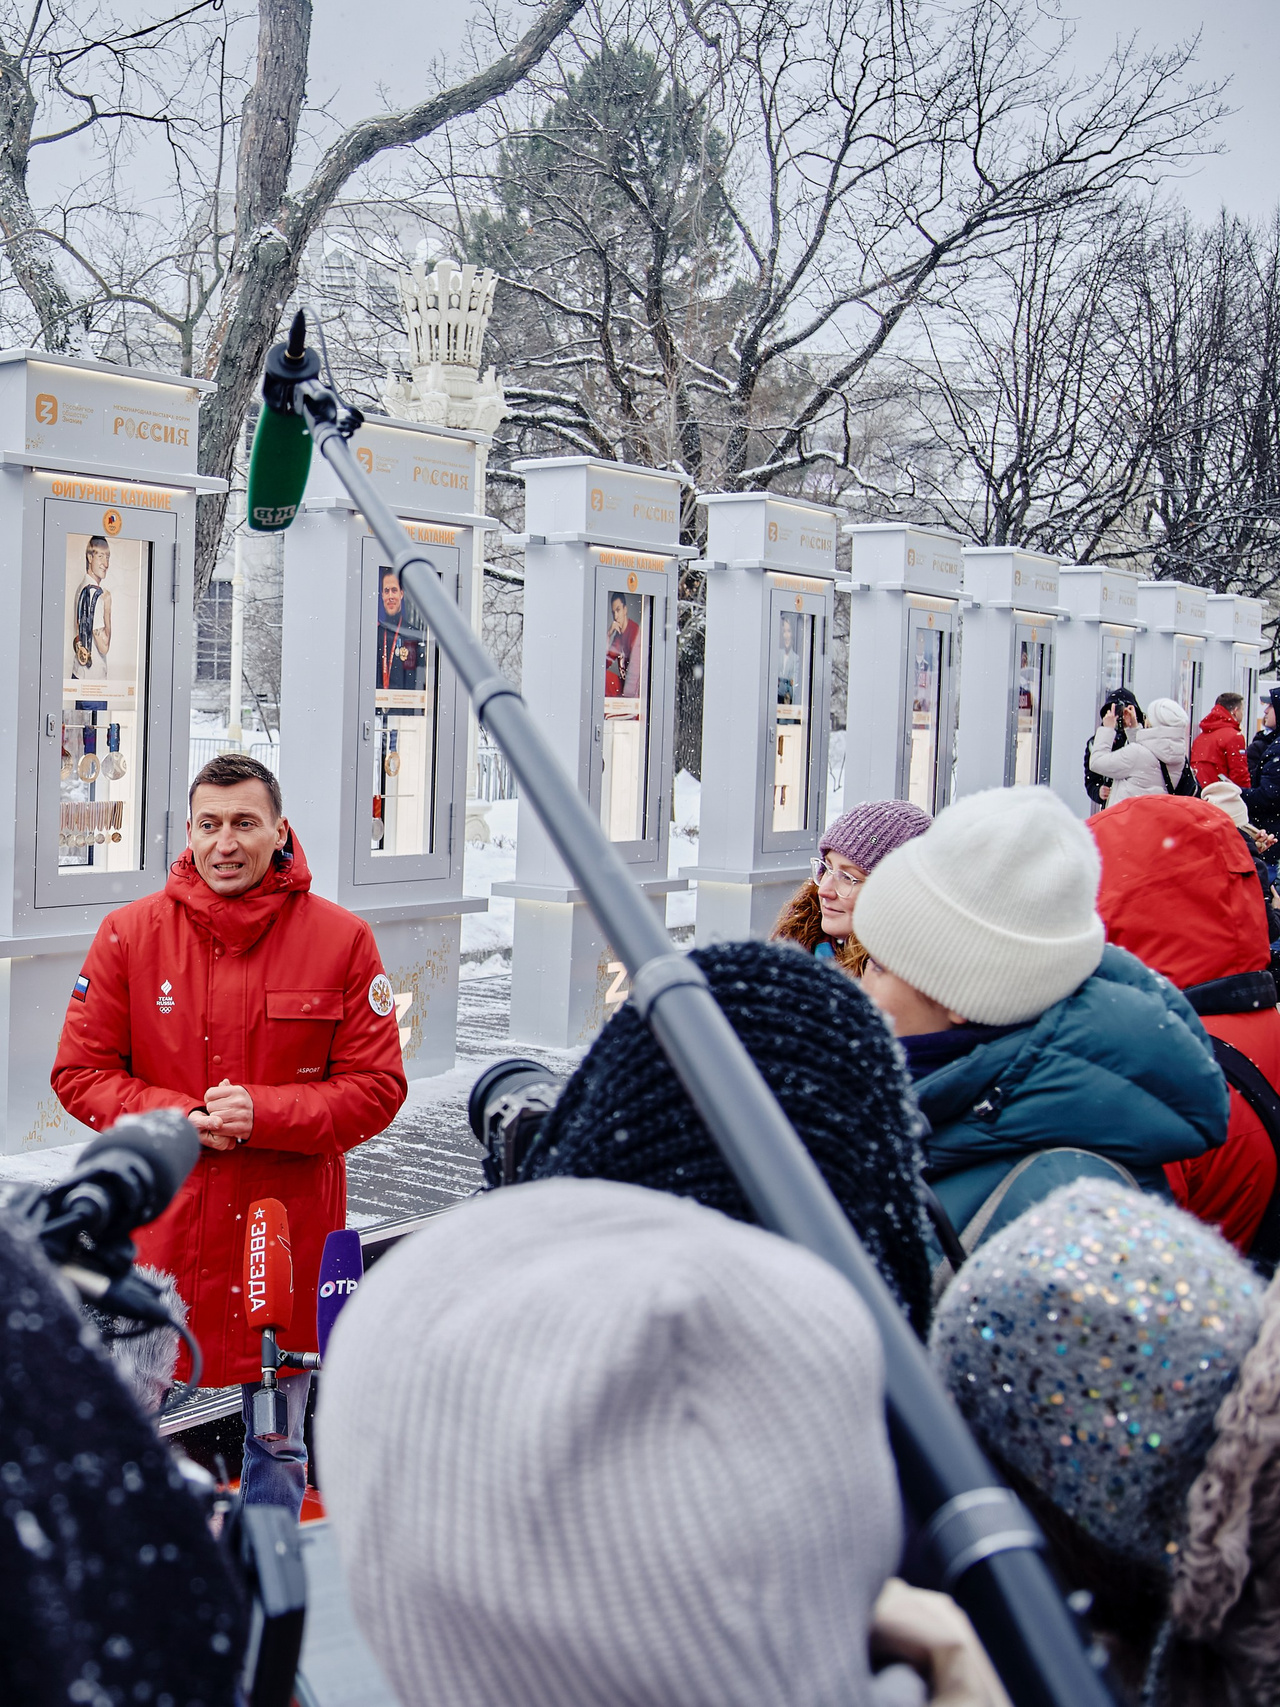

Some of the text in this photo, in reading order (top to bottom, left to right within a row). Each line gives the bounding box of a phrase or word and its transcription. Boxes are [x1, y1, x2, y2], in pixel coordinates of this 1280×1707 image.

[62, 416, 82, 425] Знание
[113, 417, 189, 447] РОССИЯ
[413, 466, 469, 490] РОССИЯ
[52, 480, 172, 510] ФИГУРНОЕ КАТАНИЕ
[417, 527, 456, 546] КАТАНИЕ
[599, 553, 665, 572] ФИГУРНОЕ КАТАНИЕ
[248, 1221, 266, 1312] ЗВЕЗДА
[320, 1279, 359, 1298] ОТР
